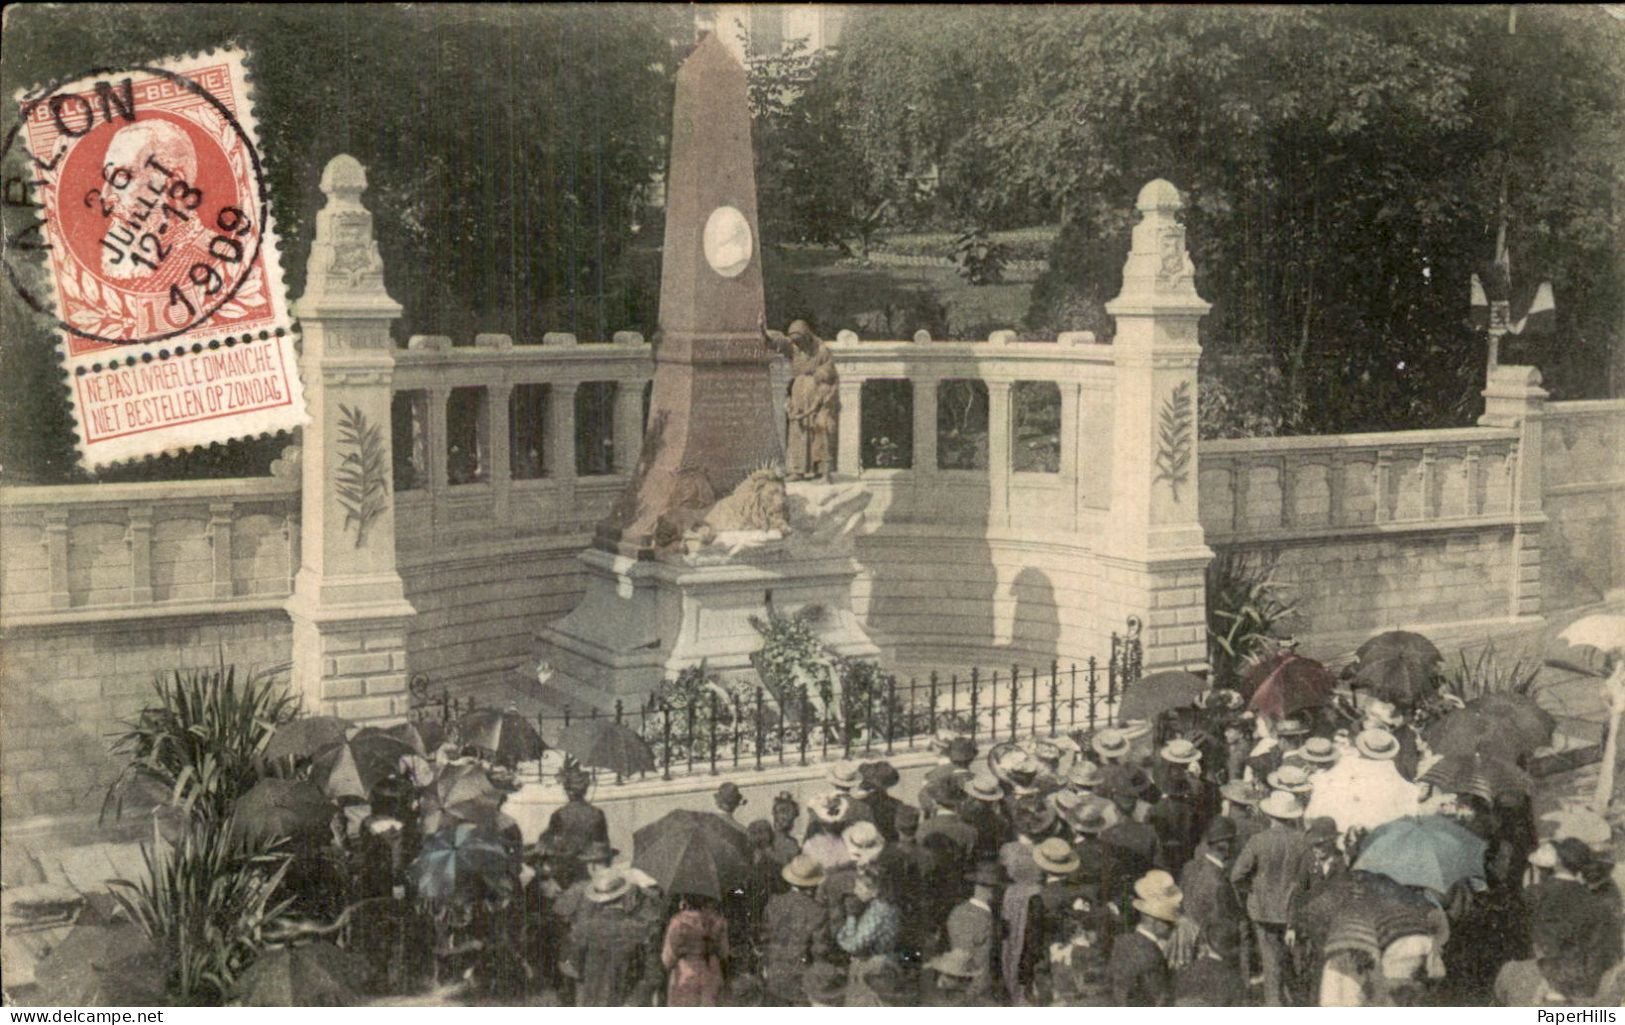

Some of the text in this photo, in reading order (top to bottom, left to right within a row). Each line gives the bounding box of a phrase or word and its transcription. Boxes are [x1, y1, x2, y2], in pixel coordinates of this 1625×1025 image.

[85, 162, 133, 218] 26
[130, 181, 203, 270] 12-13
[170, 207, 251, 315] 1909
[143, 298, 195, 333] 10
[86, 344, 276, 403] NE PAS LIVRER LE DIMANCHE
[92, 375, 282, 434] NIET BESTELLEN OP ZONDAG
